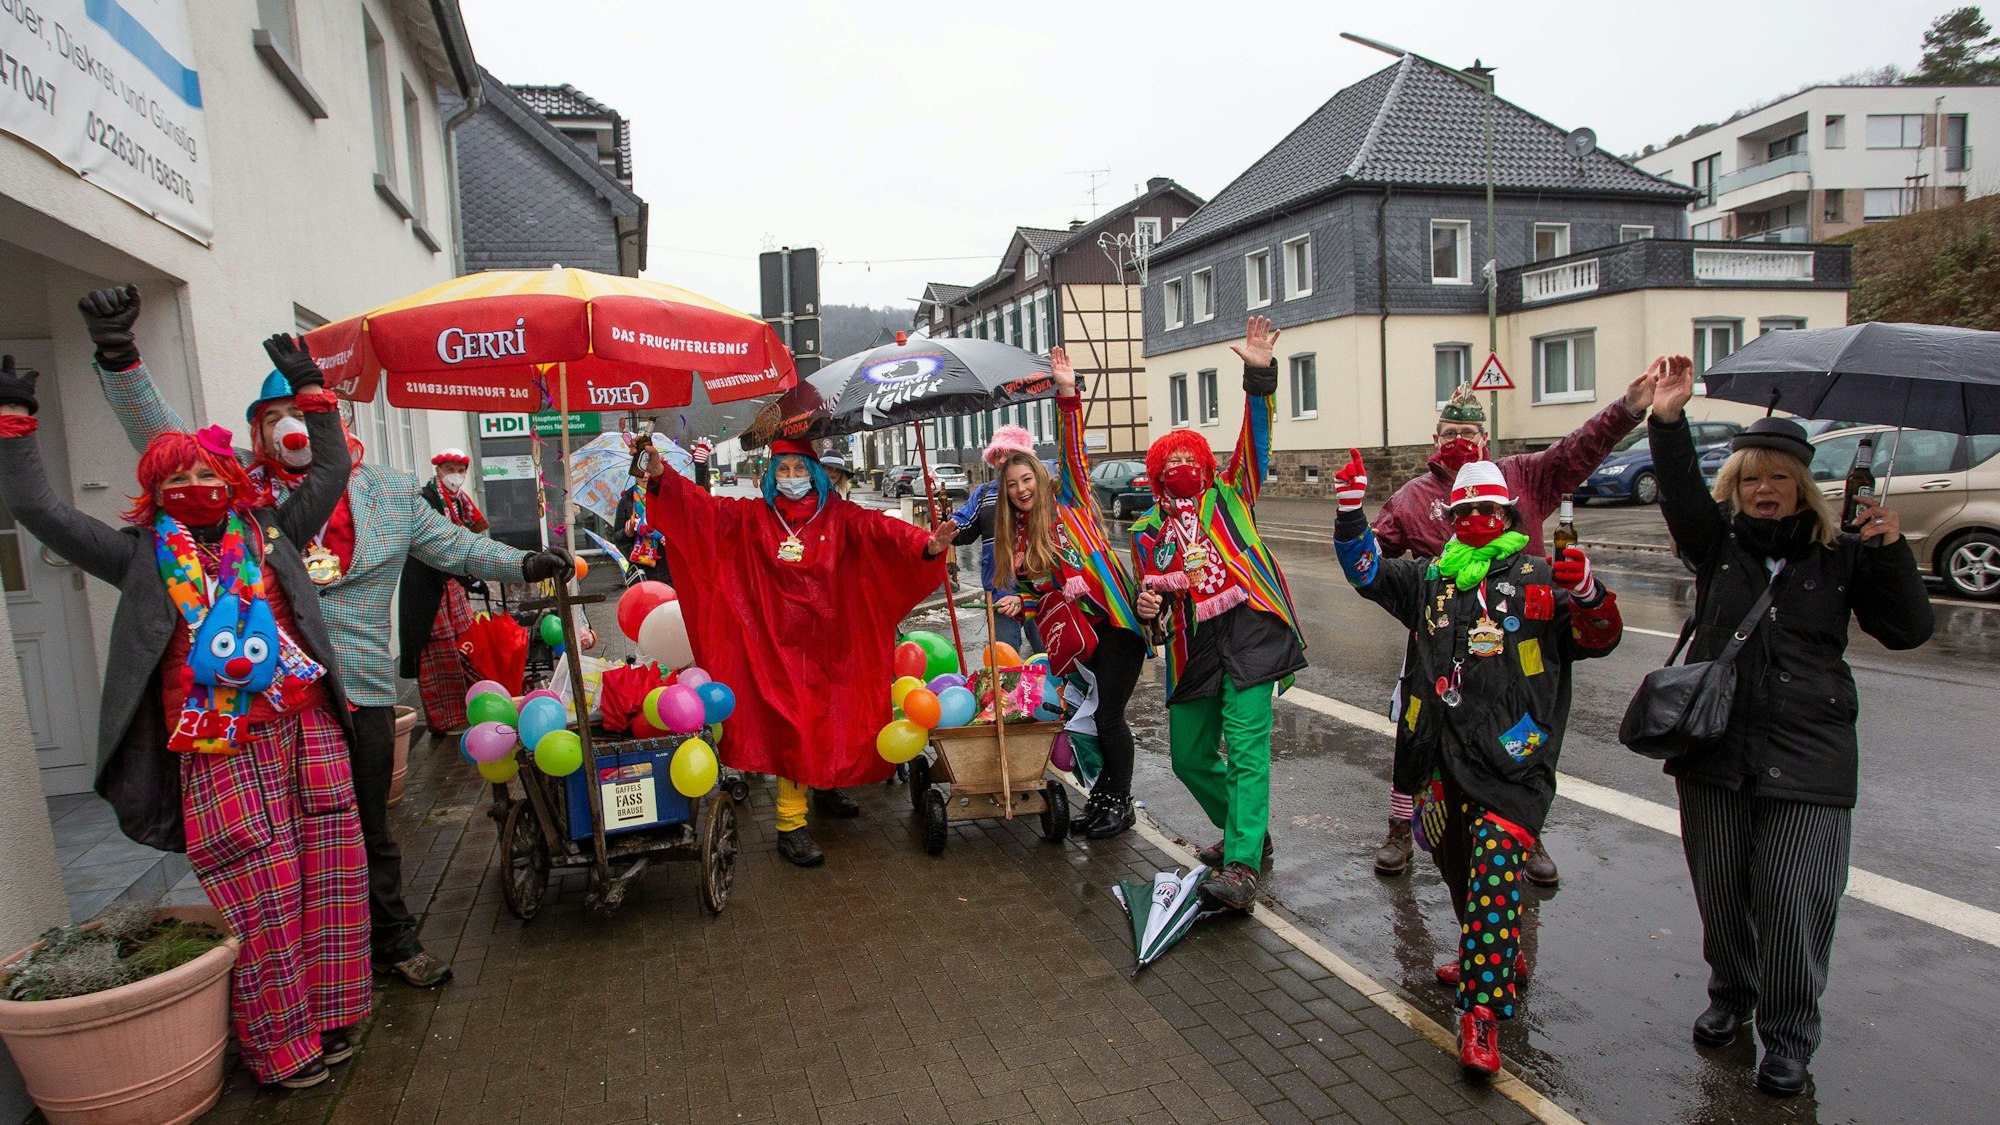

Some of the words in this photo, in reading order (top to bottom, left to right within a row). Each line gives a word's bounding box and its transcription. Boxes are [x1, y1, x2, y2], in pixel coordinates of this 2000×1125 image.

[54, 21, 118, 97] Diskret
[119, 79, 147, 119] und
[150, 99, 197, 163] Günstig
[87, 110, 195, 205] 02263/7158576
[611, 326, 636, 343] DAS
[639, 332, 749, 355] FRUCHTERLEBNIS
[1025, 379, 1053, 396] VODKA
[485, 416, 524, 433] HDI
[783, 420, 809, 437] VODKA
[615, 783, 642, 795] GAFFELS
[616, 792, 643, 808] FASS
[617, 806, 644, 817] BRAUSE
